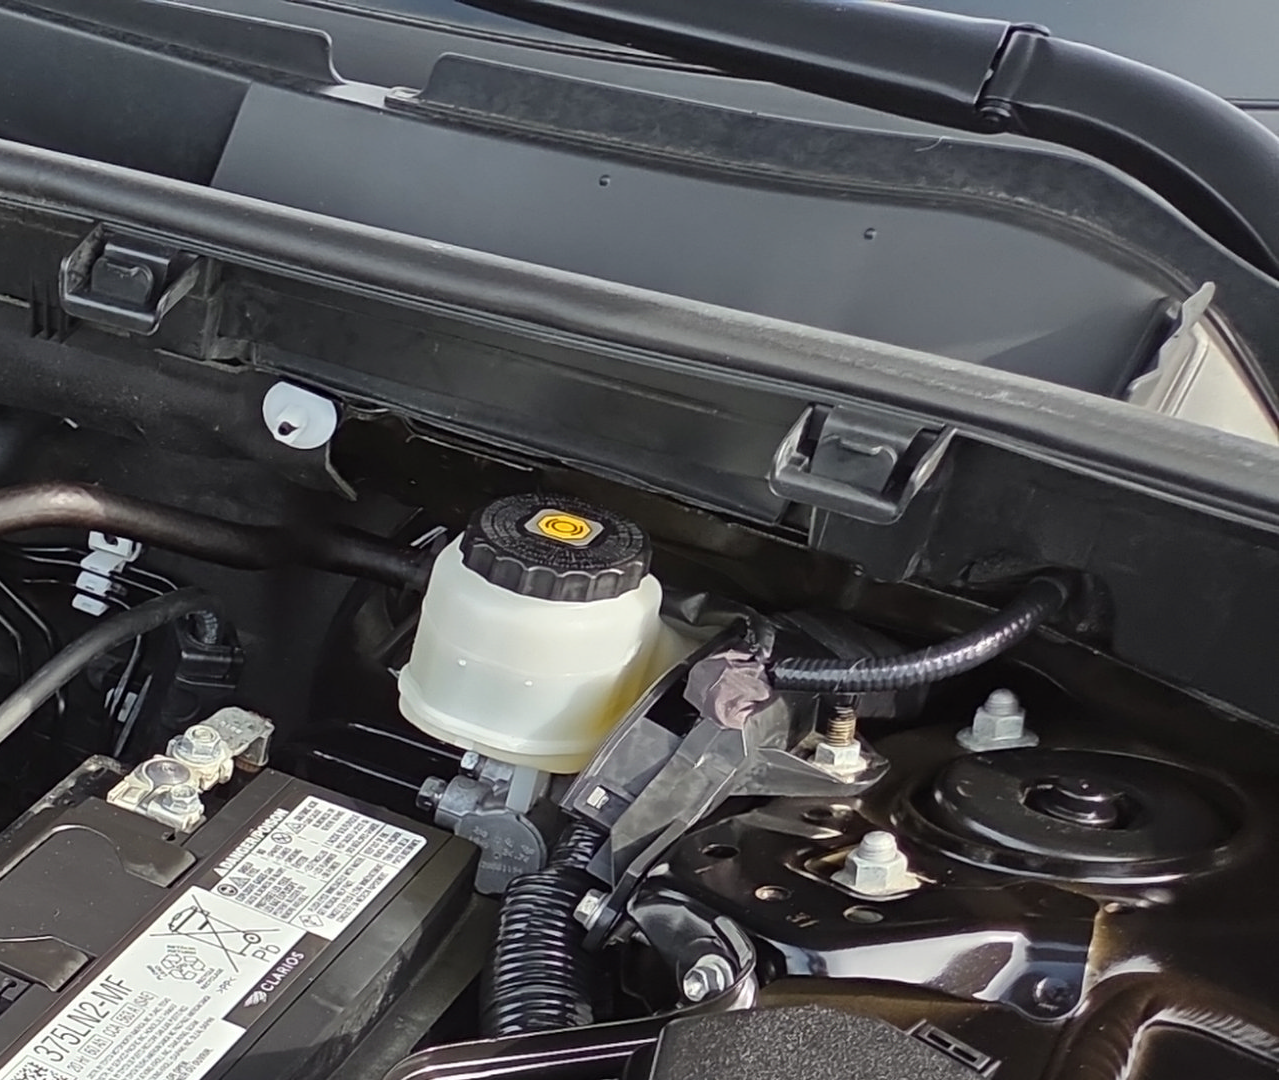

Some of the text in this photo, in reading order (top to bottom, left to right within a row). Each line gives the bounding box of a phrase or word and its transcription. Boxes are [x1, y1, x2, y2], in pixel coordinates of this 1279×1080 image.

[251, 940, 282, 963] Pb
[258, 950, 306, 992] CLARIOS
[32, 973, 133, 1064] 375LN2-MF
